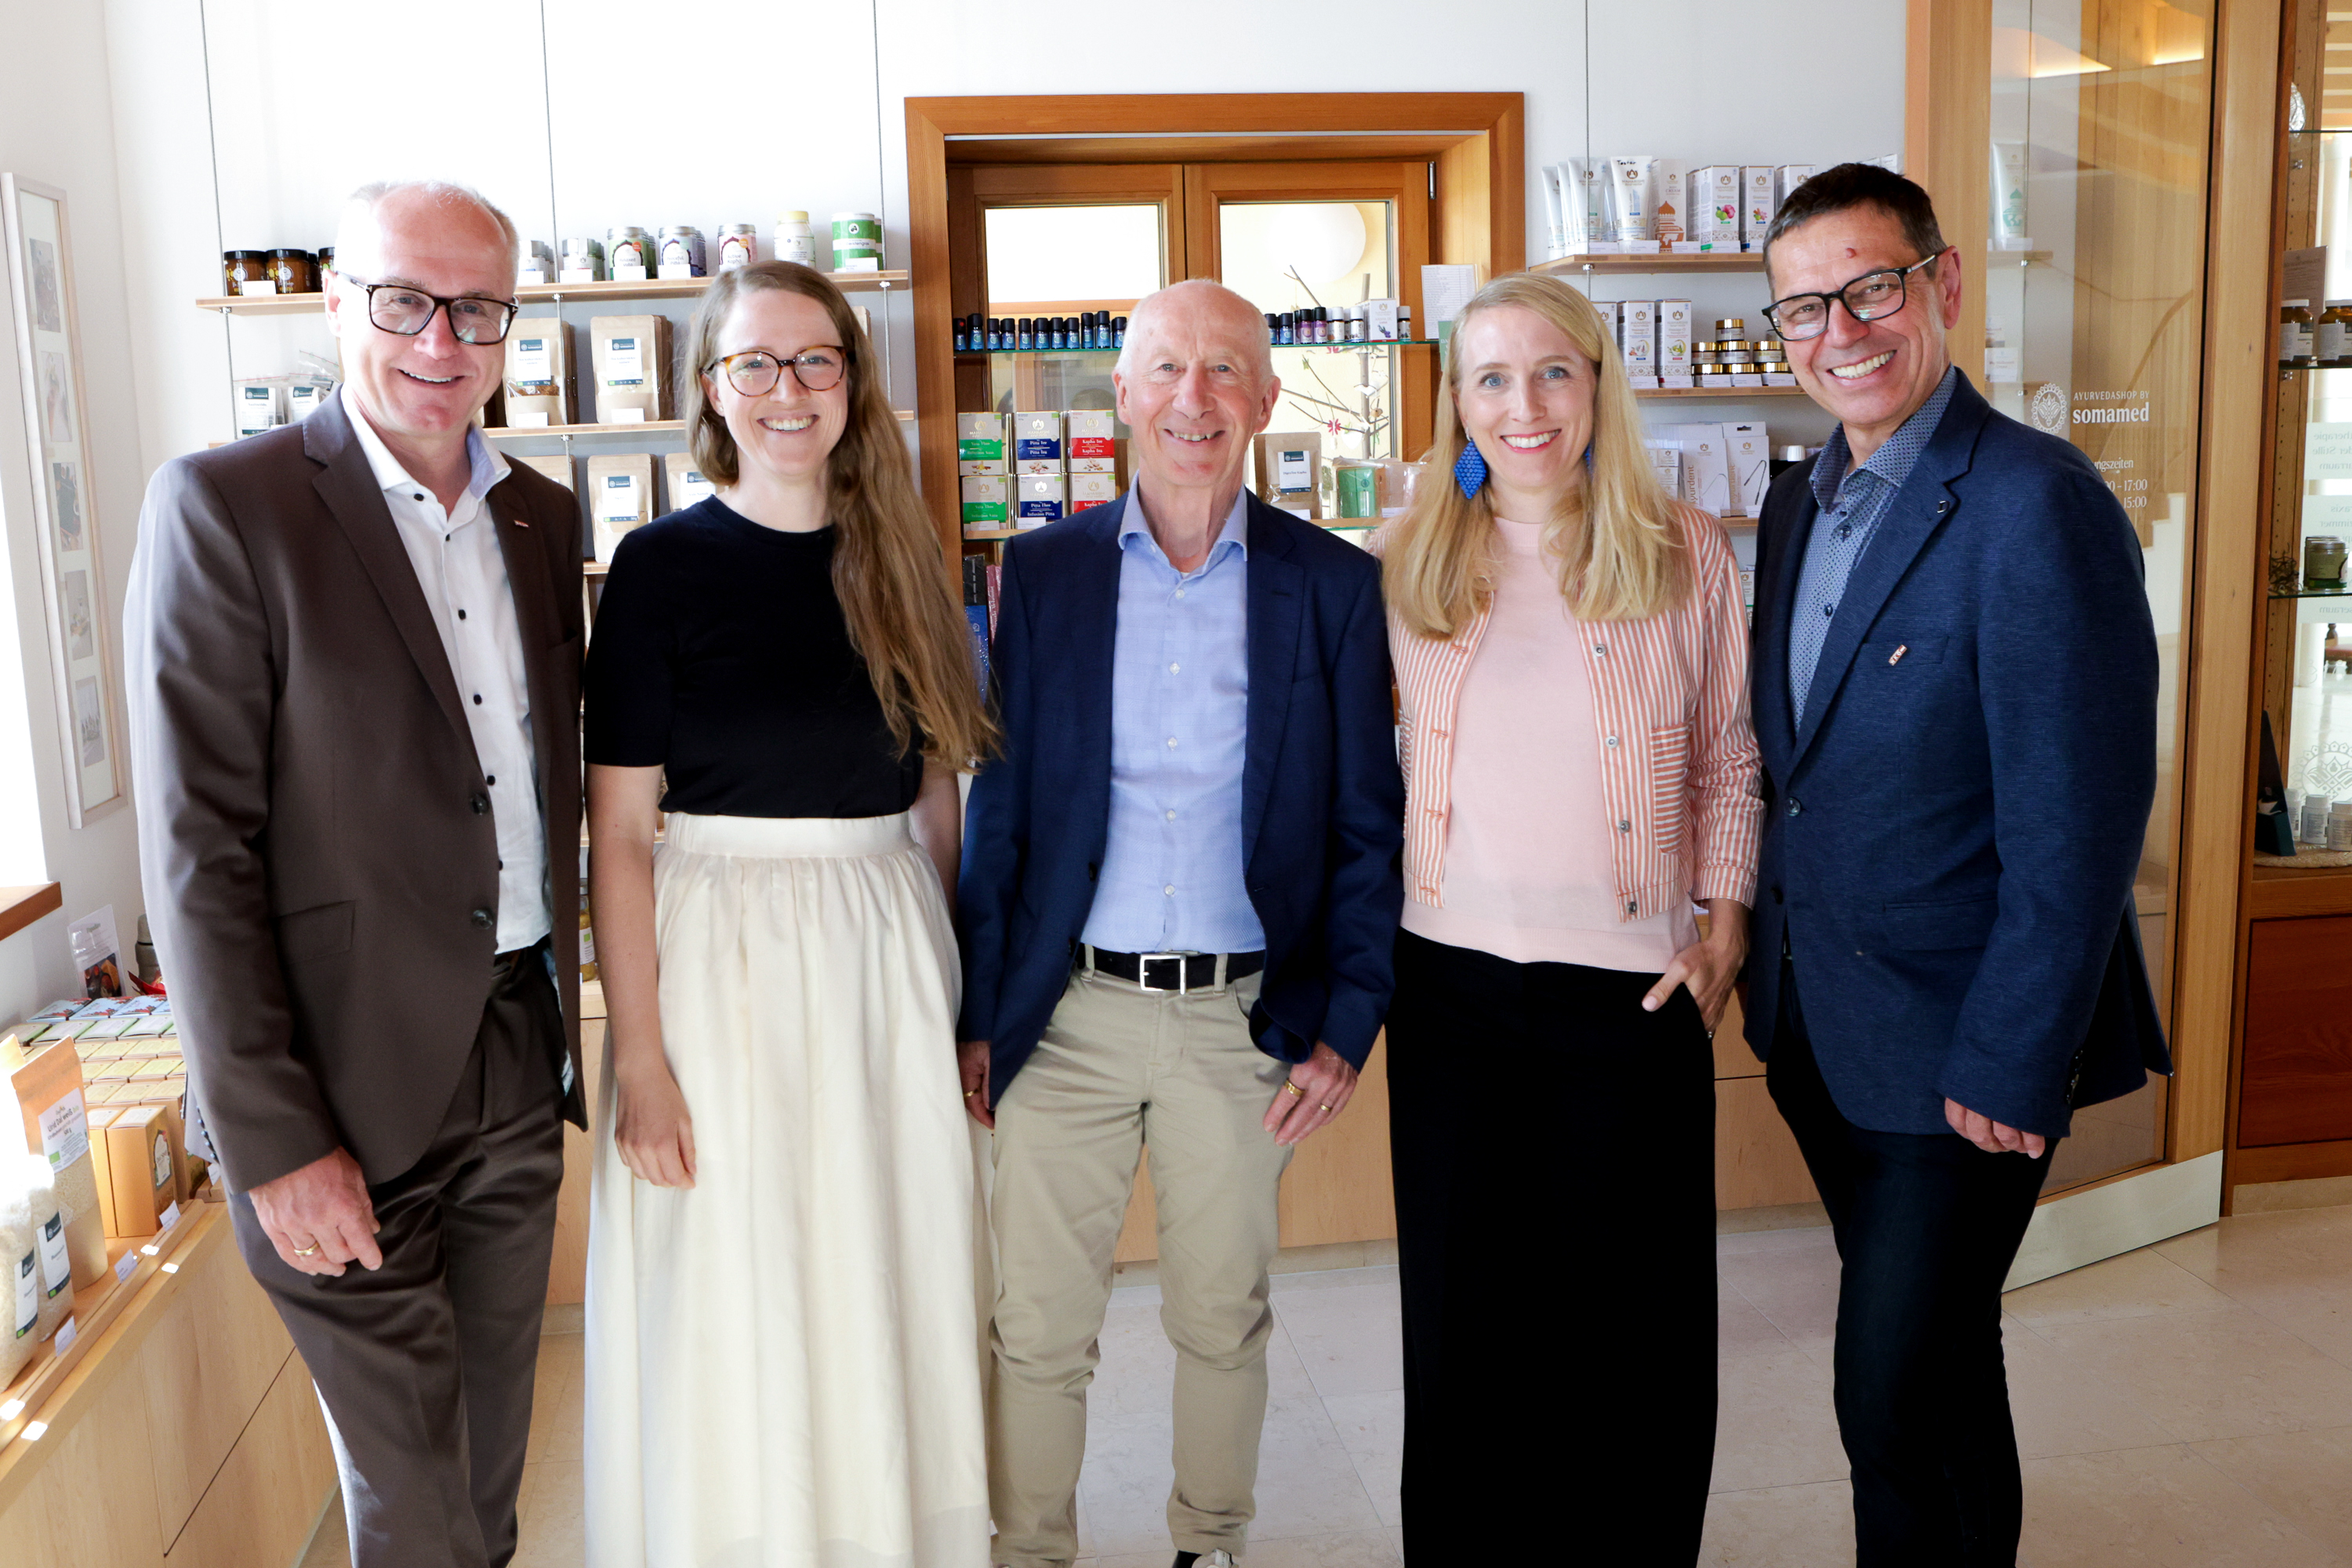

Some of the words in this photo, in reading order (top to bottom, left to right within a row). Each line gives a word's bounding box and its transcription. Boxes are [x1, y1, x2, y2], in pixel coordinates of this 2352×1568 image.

[2074, 391, 2138, 401] AYURVEDASHOP
[2140, 390, 2150, 400] BY
[2072, 401, 2150, 424] somamed
[2124, 478, 2148, 492] 17:00
[2123, 495, 2147, 509] 15:00
